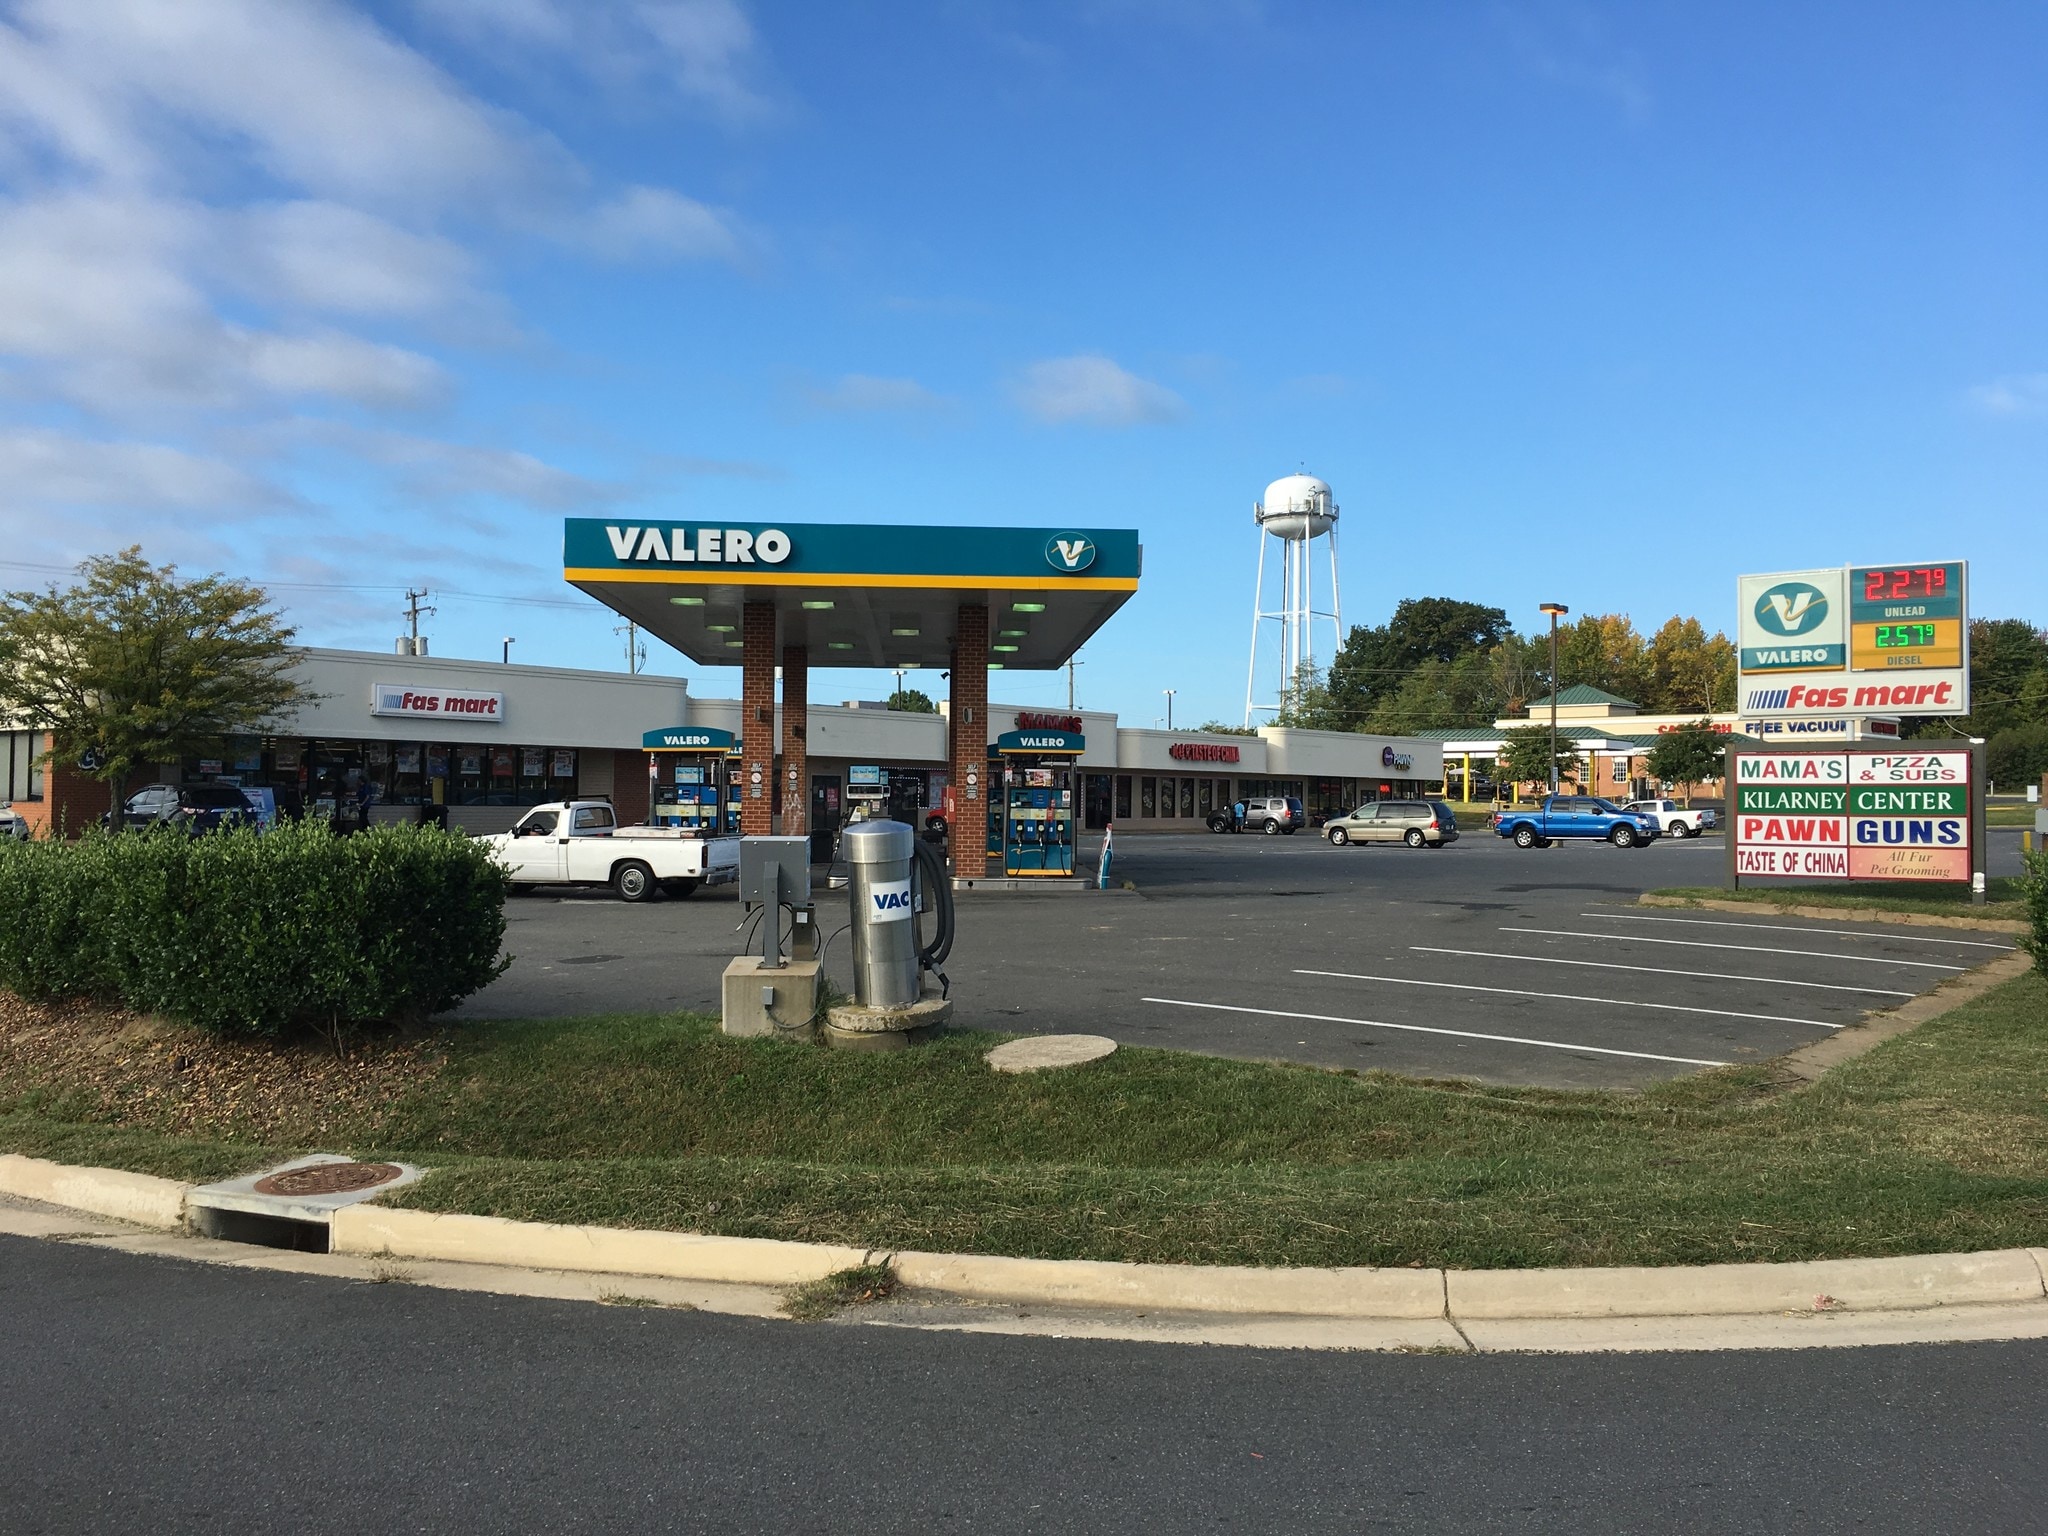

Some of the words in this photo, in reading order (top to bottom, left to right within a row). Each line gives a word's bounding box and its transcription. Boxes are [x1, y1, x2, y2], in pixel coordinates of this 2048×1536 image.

[605, 526, 791, 564] VALERO
[1885, 606, 1926, 617] UNLEAD
[1755, 648, 1828, 664] VALERO
[1887, 655, 1923, 666] DIESEL
[401, 692, 440, 711] fas
[444, 697, 498, 714] mart
[1786, 685, 1849, 709] fas
[1853, 681, 1953, 707] mart
[1018, 712, 1083, 734] MAMA'S
[664, 735, 710, 745] VALERO
[1020, 737, 1065, 747] VALERO
[1741, 760, 1842, 779] MAMA'S
[1871, 757, 1943, 768] PIZZA
[1859, 770, 1875, 780] &
[1889, 769, 1956, 781] SUBS
[1744, 791, 1847, 809] KILARNEY
[1857, 792, 1953, 810] CENTER
[1744, 818, 1840, 842] PAWN
[1857, 820, 1961, 844] GUNS
[1738, 851, 1776, 871] TASTE
[1783, 852, 1799, 873] OF
[1805, 852, 1846, 874] CHINA
[1886, 851, 1906, 862] All
[1909, 851, 1933, 862] Fur
[1870, 864, 1889, 875] Pet
[1891, 865, 1951, 878] Grooming
[873, 890, 910, 910] VAC
